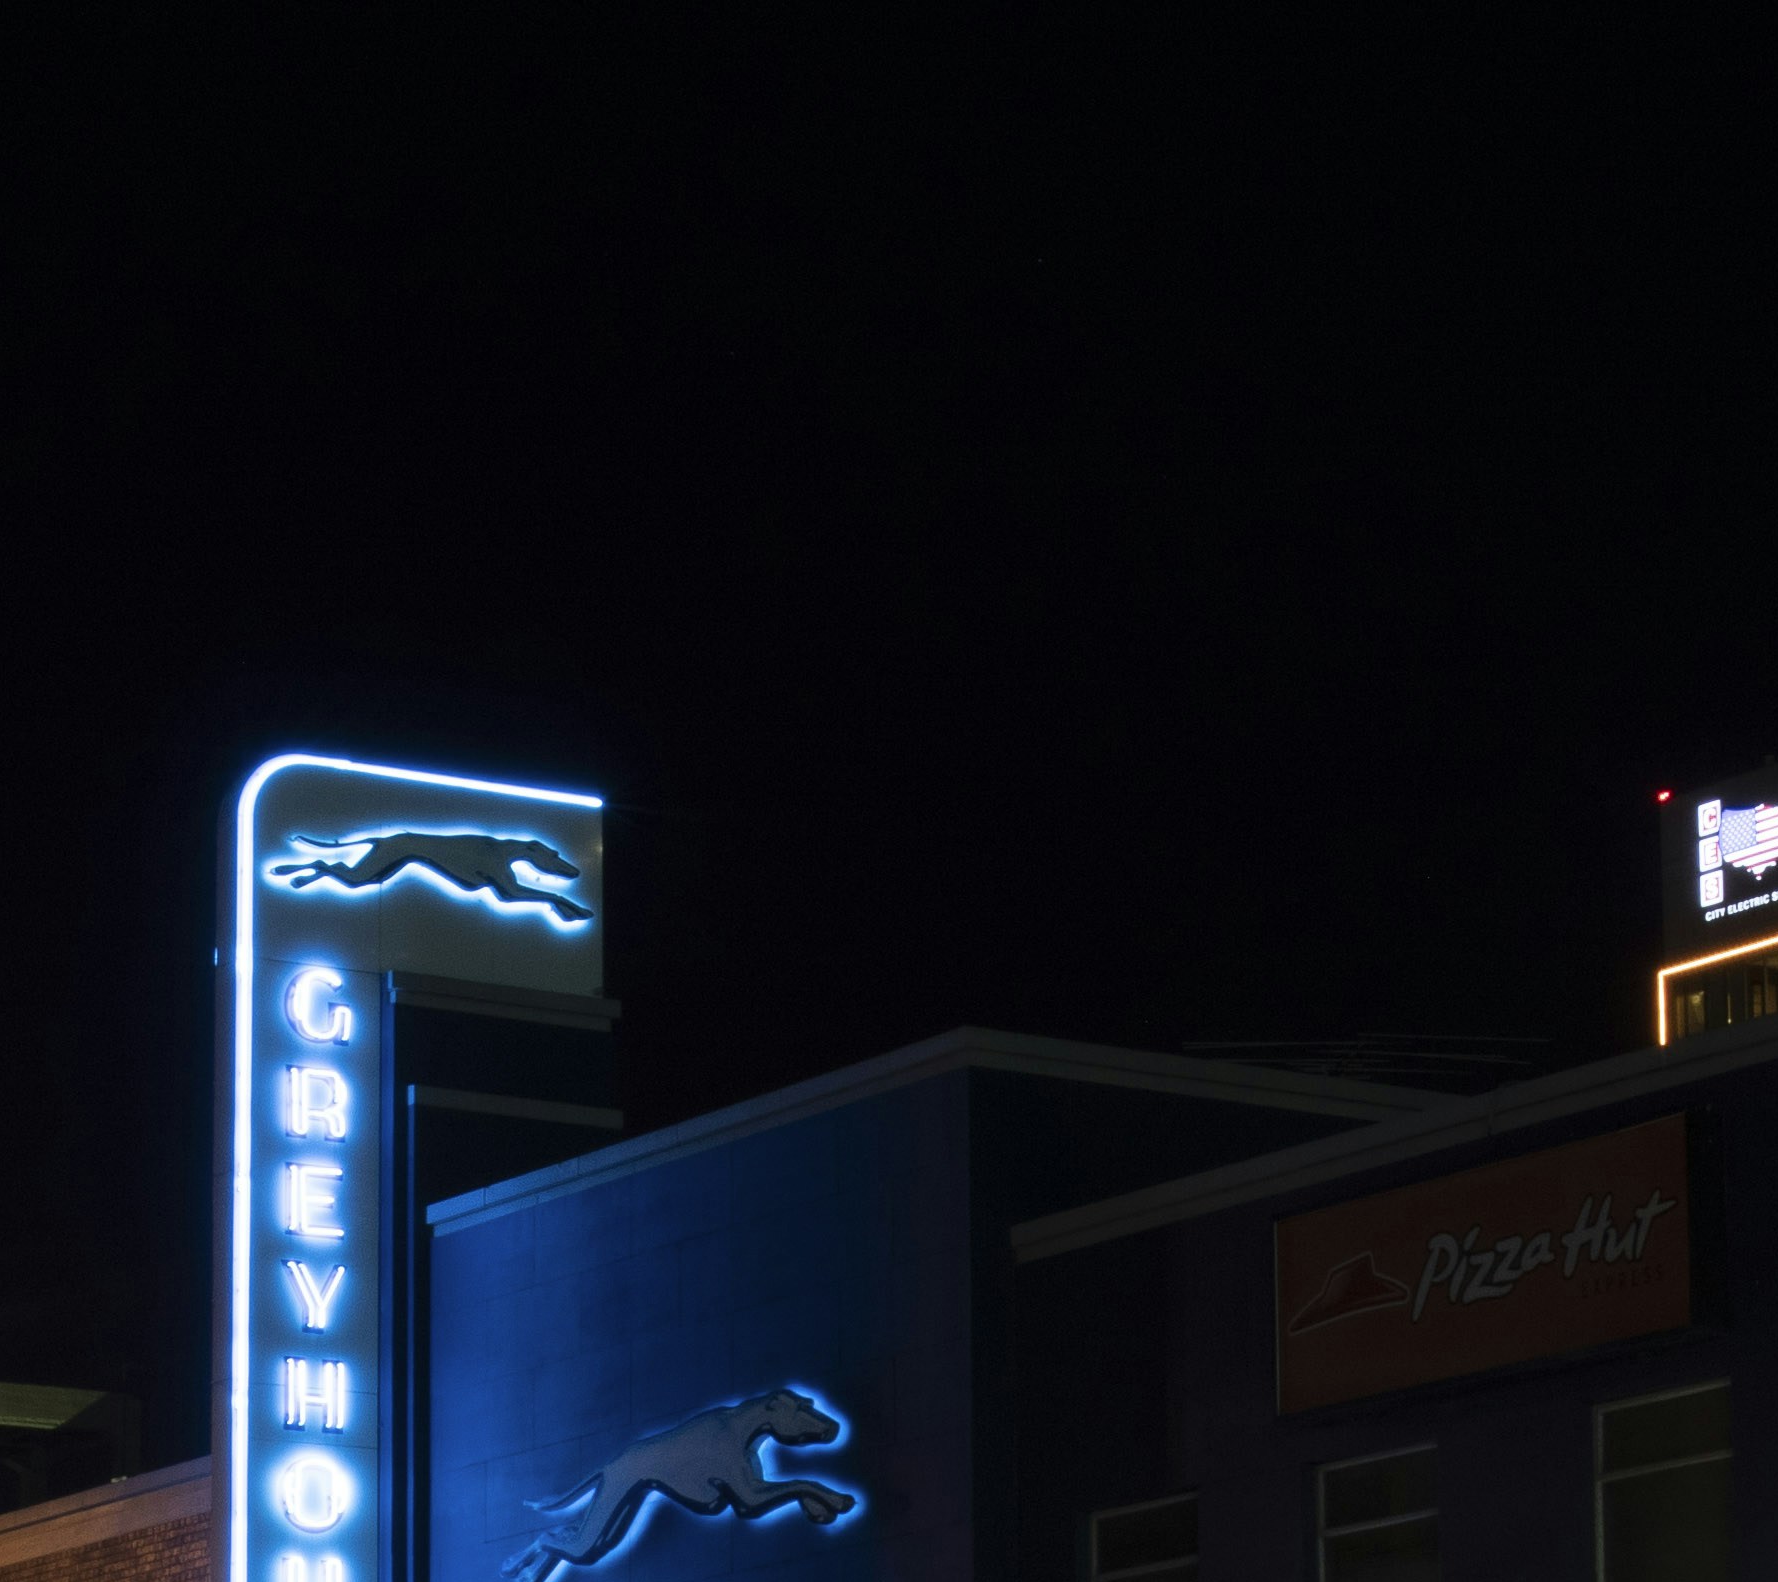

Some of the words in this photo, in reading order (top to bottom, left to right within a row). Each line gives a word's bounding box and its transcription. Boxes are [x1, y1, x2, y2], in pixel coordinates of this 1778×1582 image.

[1705, 907, 1726, 922] CITY
[1727, 894, 1770, 915] ELECTRIC
[1412, 1223, 1555, 1323] Pizza
[1561, 1189, 1678, 1279] Hut
